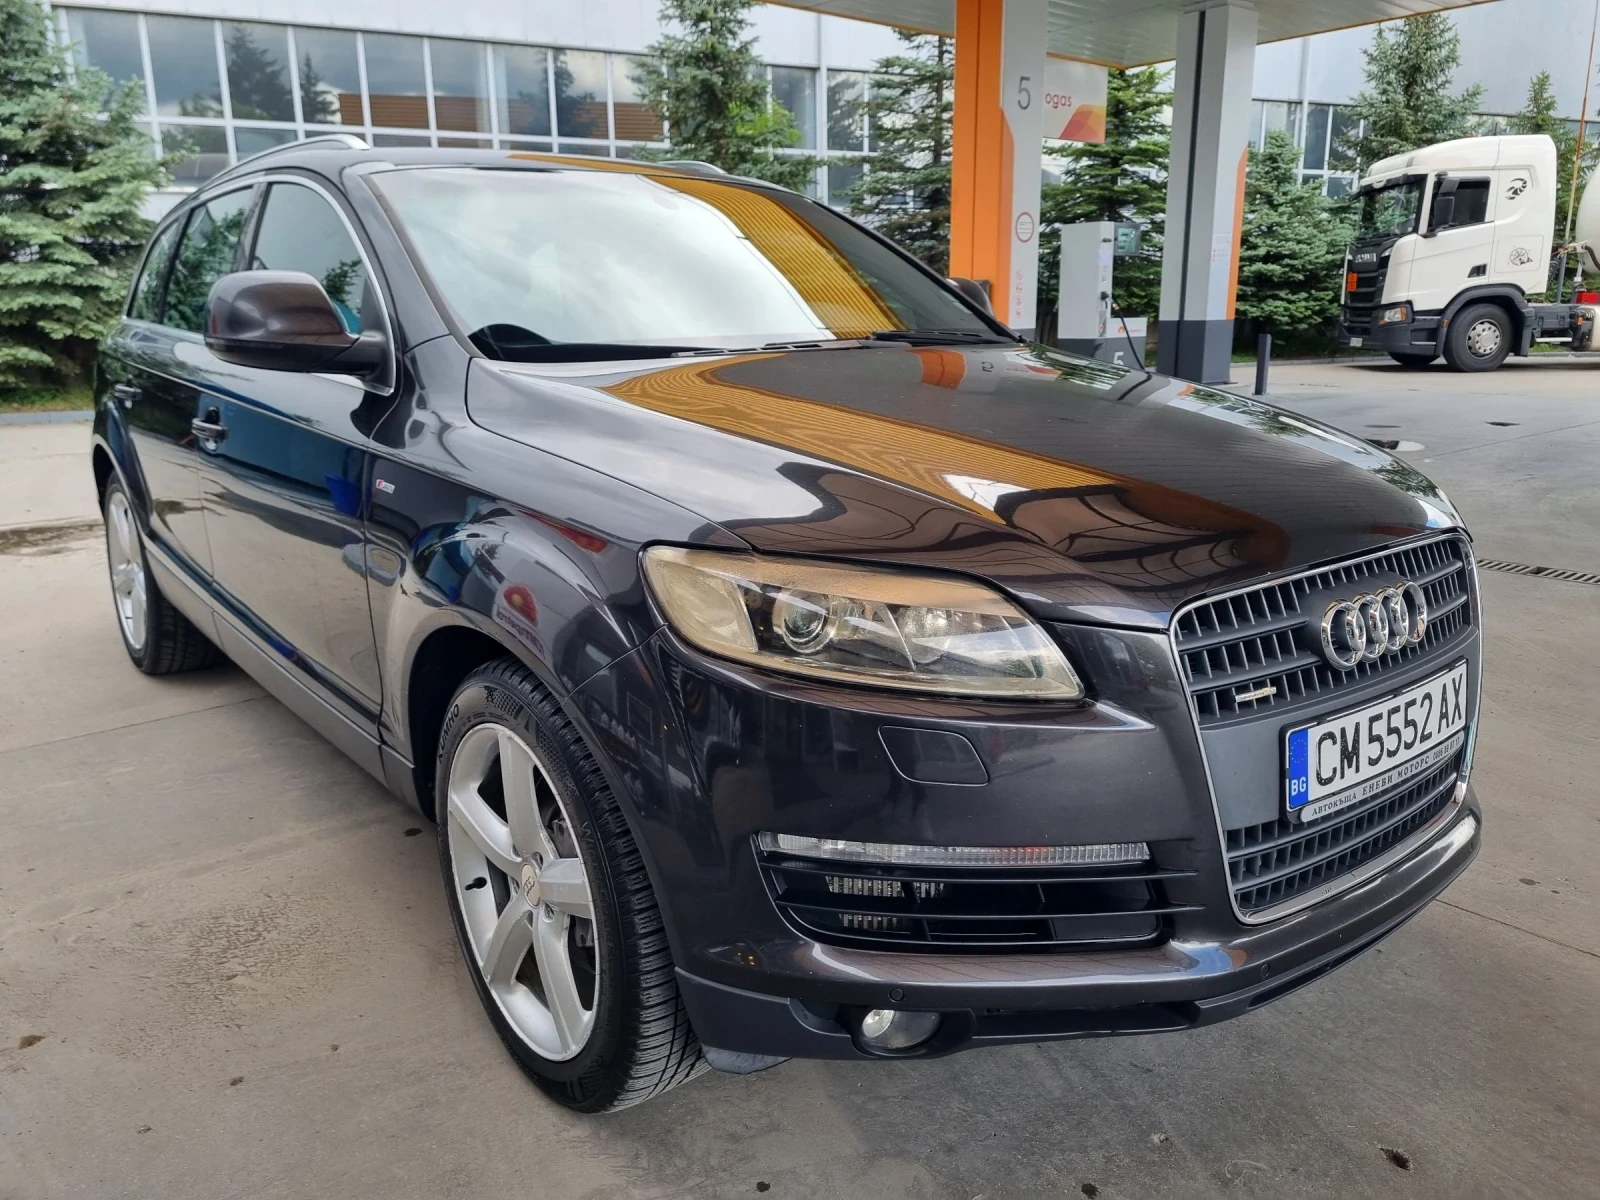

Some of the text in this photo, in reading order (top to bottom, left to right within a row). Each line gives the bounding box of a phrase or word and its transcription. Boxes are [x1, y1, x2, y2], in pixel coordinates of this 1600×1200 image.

[1017, 75, 1031, 110] 5
[1045, 92, 1072, 109] ogas
[1291, 776, 1307, 796] BG
[1362, 775, 1393, 795] ЕНЕВИ
[1396, 755, 1430, 779] МОТОРС
